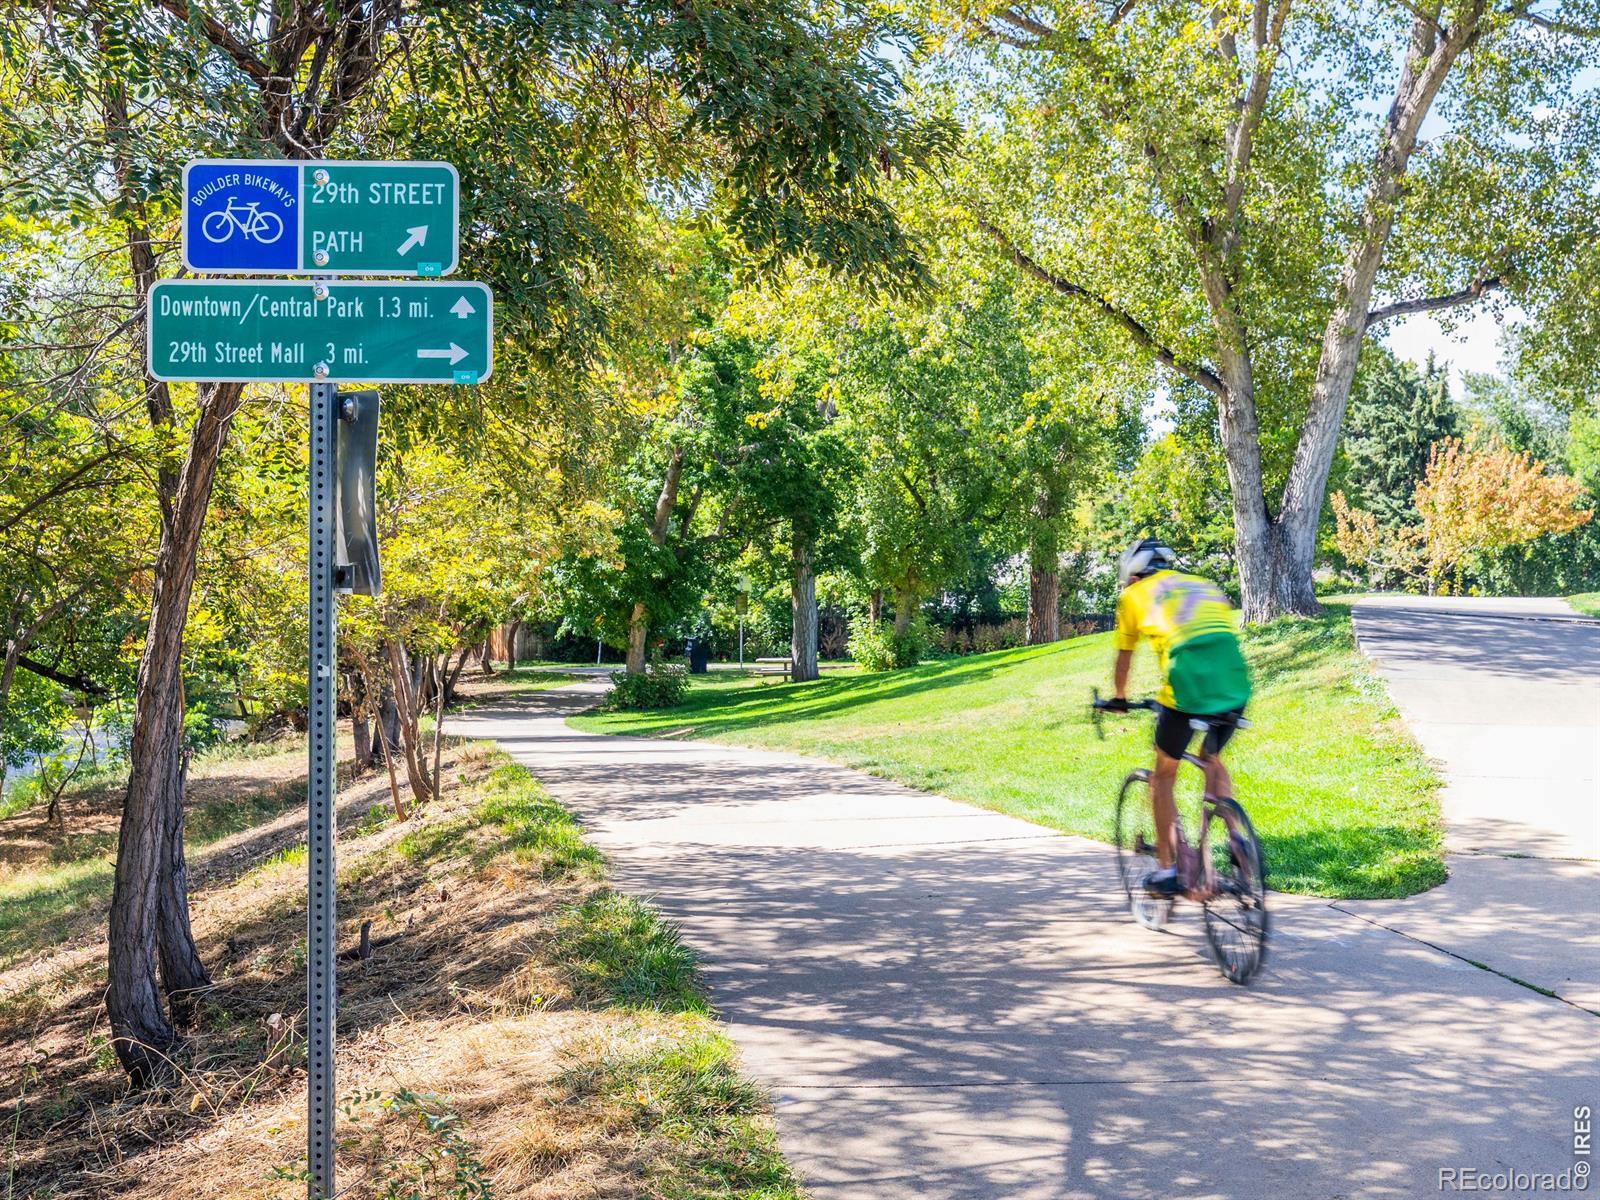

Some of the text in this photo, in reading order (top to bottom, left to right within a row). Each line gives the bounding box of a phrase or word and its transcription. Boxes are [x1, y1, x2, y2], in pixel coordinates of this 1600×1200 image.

[191, 173, 296, 208] BOULDER BIKEWAYS
[312, 182, 446, 205] 29th STREET
[312, 231, 363, 253] PATH
[160, 293, 434, 325] Downtown/Central Park 1.3 mi.
[169, 341, 207, 363] 29th
[215, 341, 263, 363] Street
[271, 342, 305, 364] Mall
[344, 343, 369, 364] mi.
